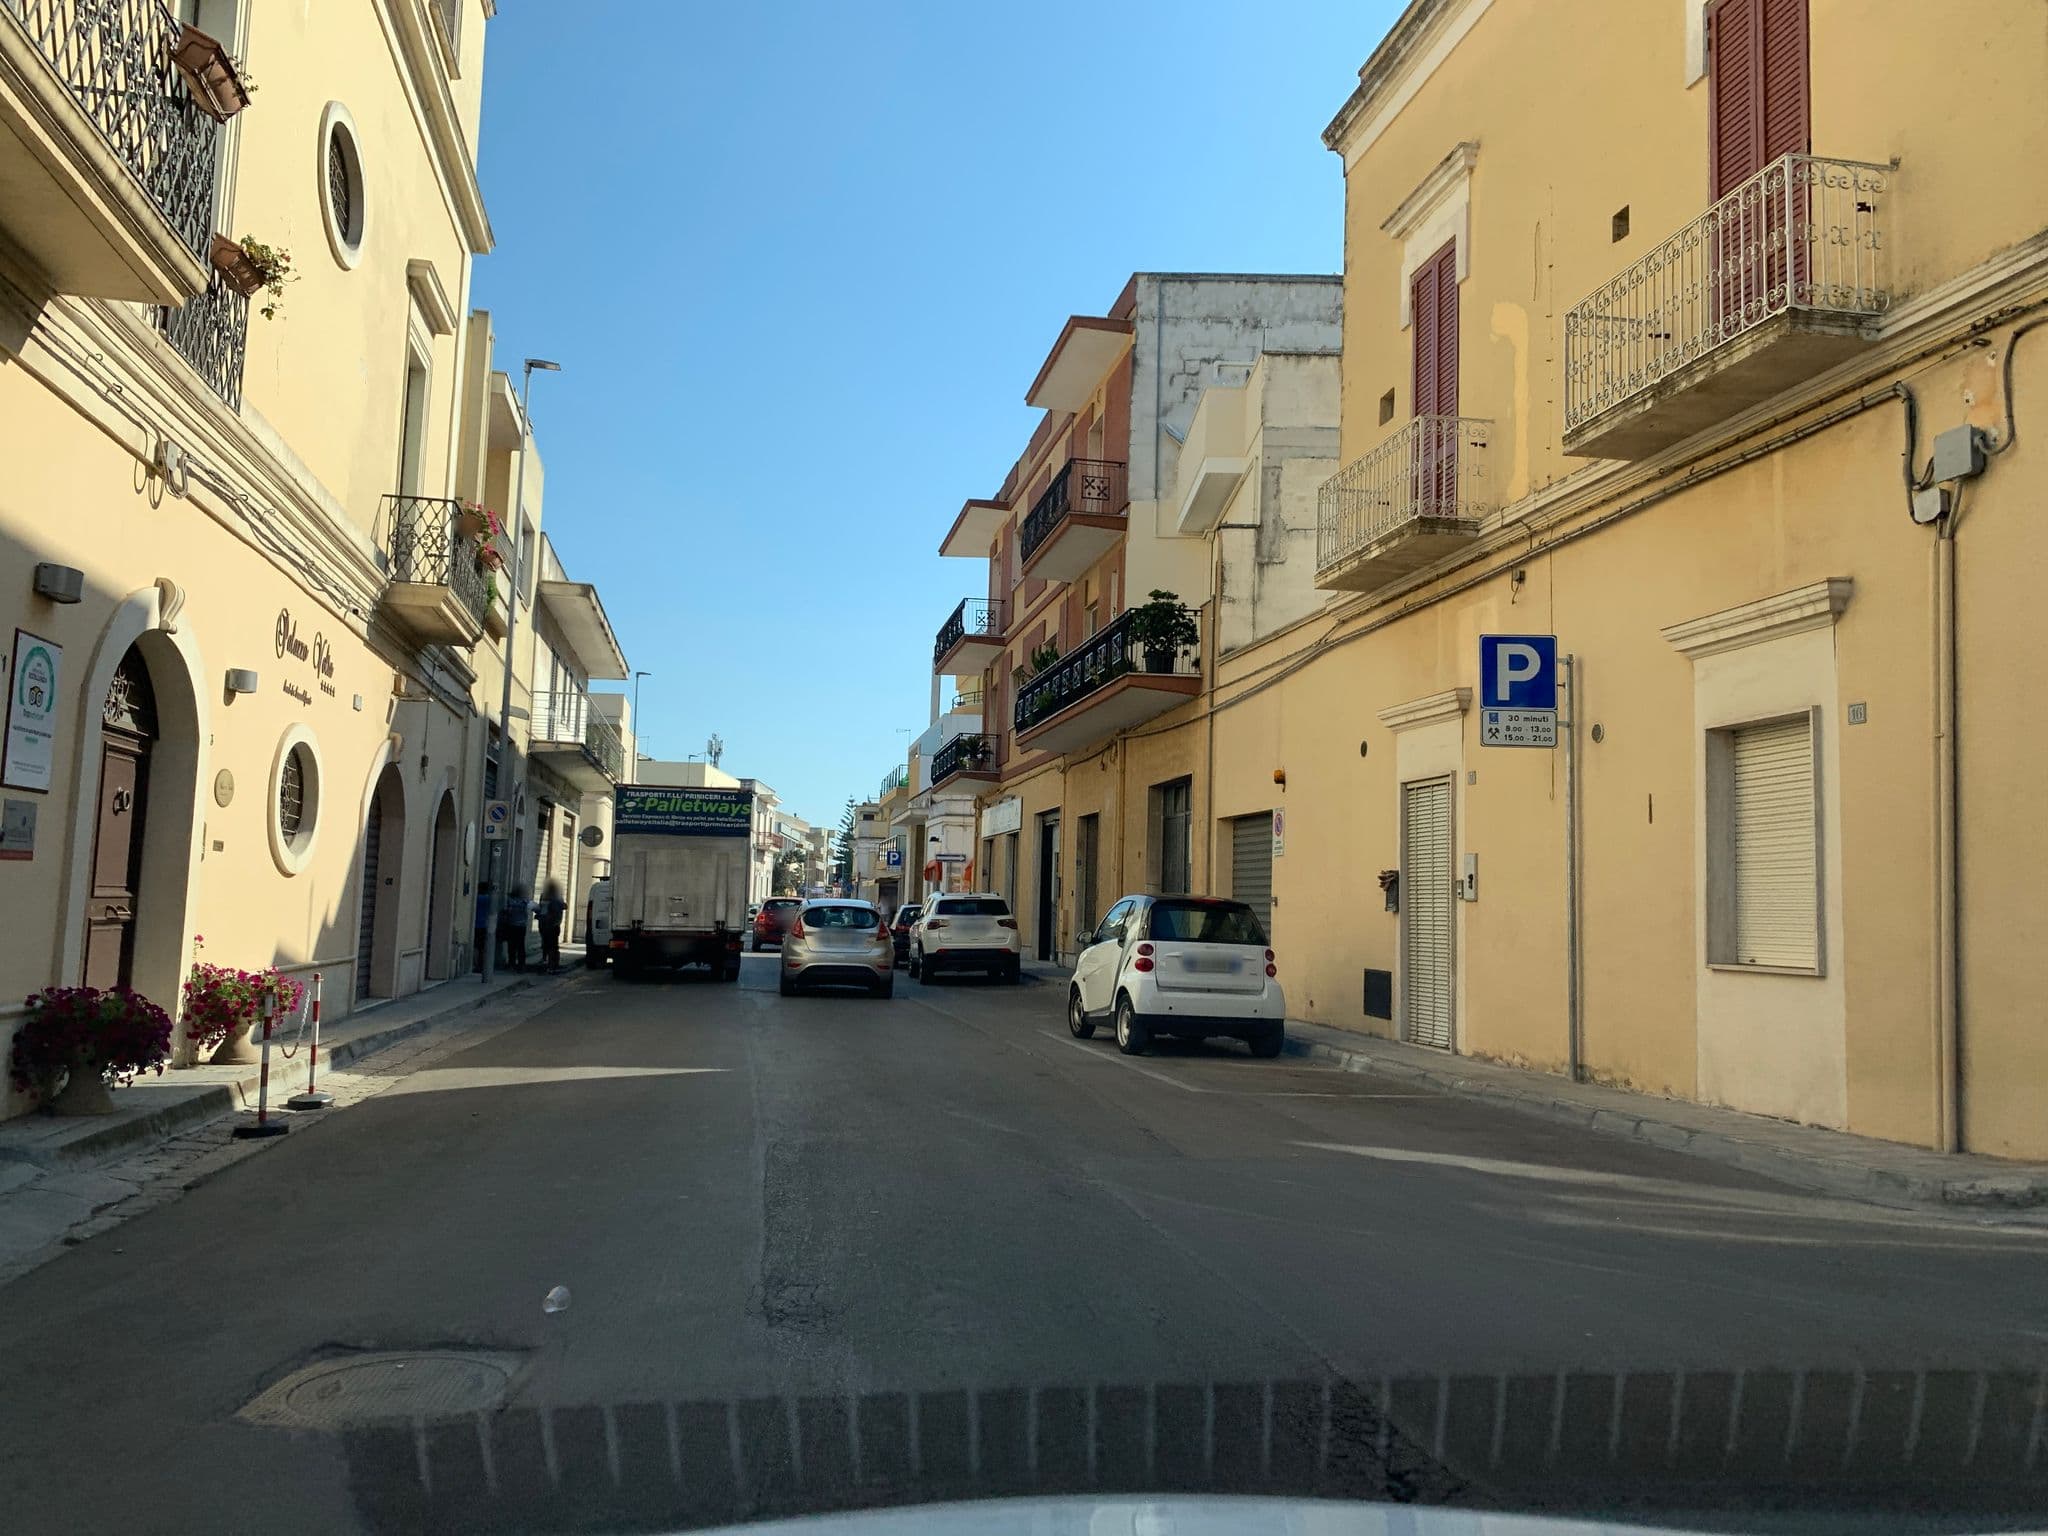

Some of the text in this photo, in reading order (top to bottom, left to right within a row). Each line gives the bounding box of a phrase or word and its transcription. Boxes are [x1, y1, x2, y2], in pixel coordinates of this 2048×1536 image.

[1496, 643, 1541, 701] P
[1508, 714, 1549, 723] 30 minuti
[644, 797, 751, 817] Palletways
[889, 852, 899, 864] P
